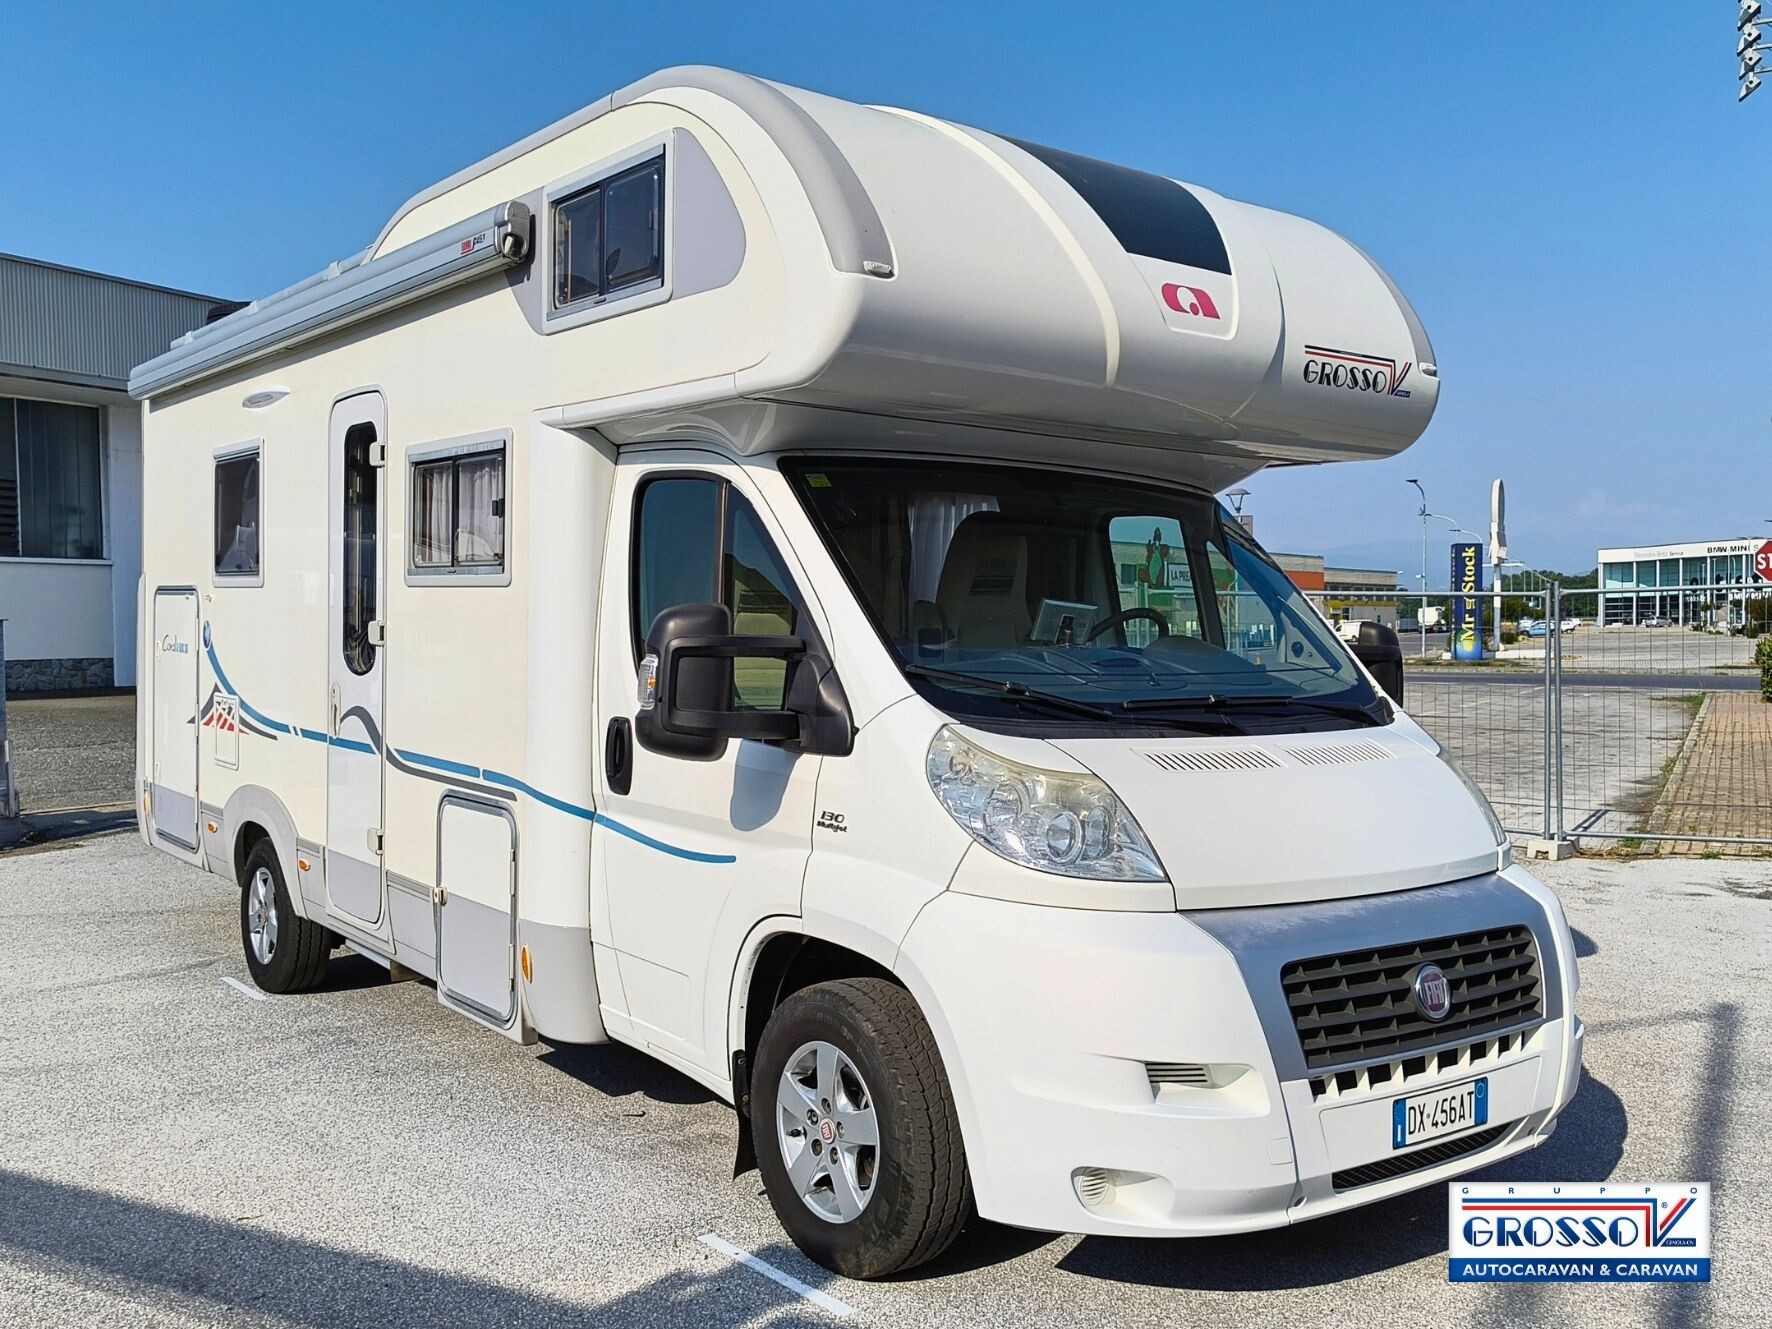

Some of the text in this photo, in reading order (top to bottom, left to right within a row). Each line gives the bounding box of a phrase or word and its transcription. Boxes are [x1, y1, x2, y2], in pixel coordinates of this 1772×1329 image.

[1303, 359, 1387, 393] GROSSO
[1461, 546, 1475, 641] Mr Stock
[820, 810, 845, 824] 130
[1431, 1090, 1474, 1129] 456AT
